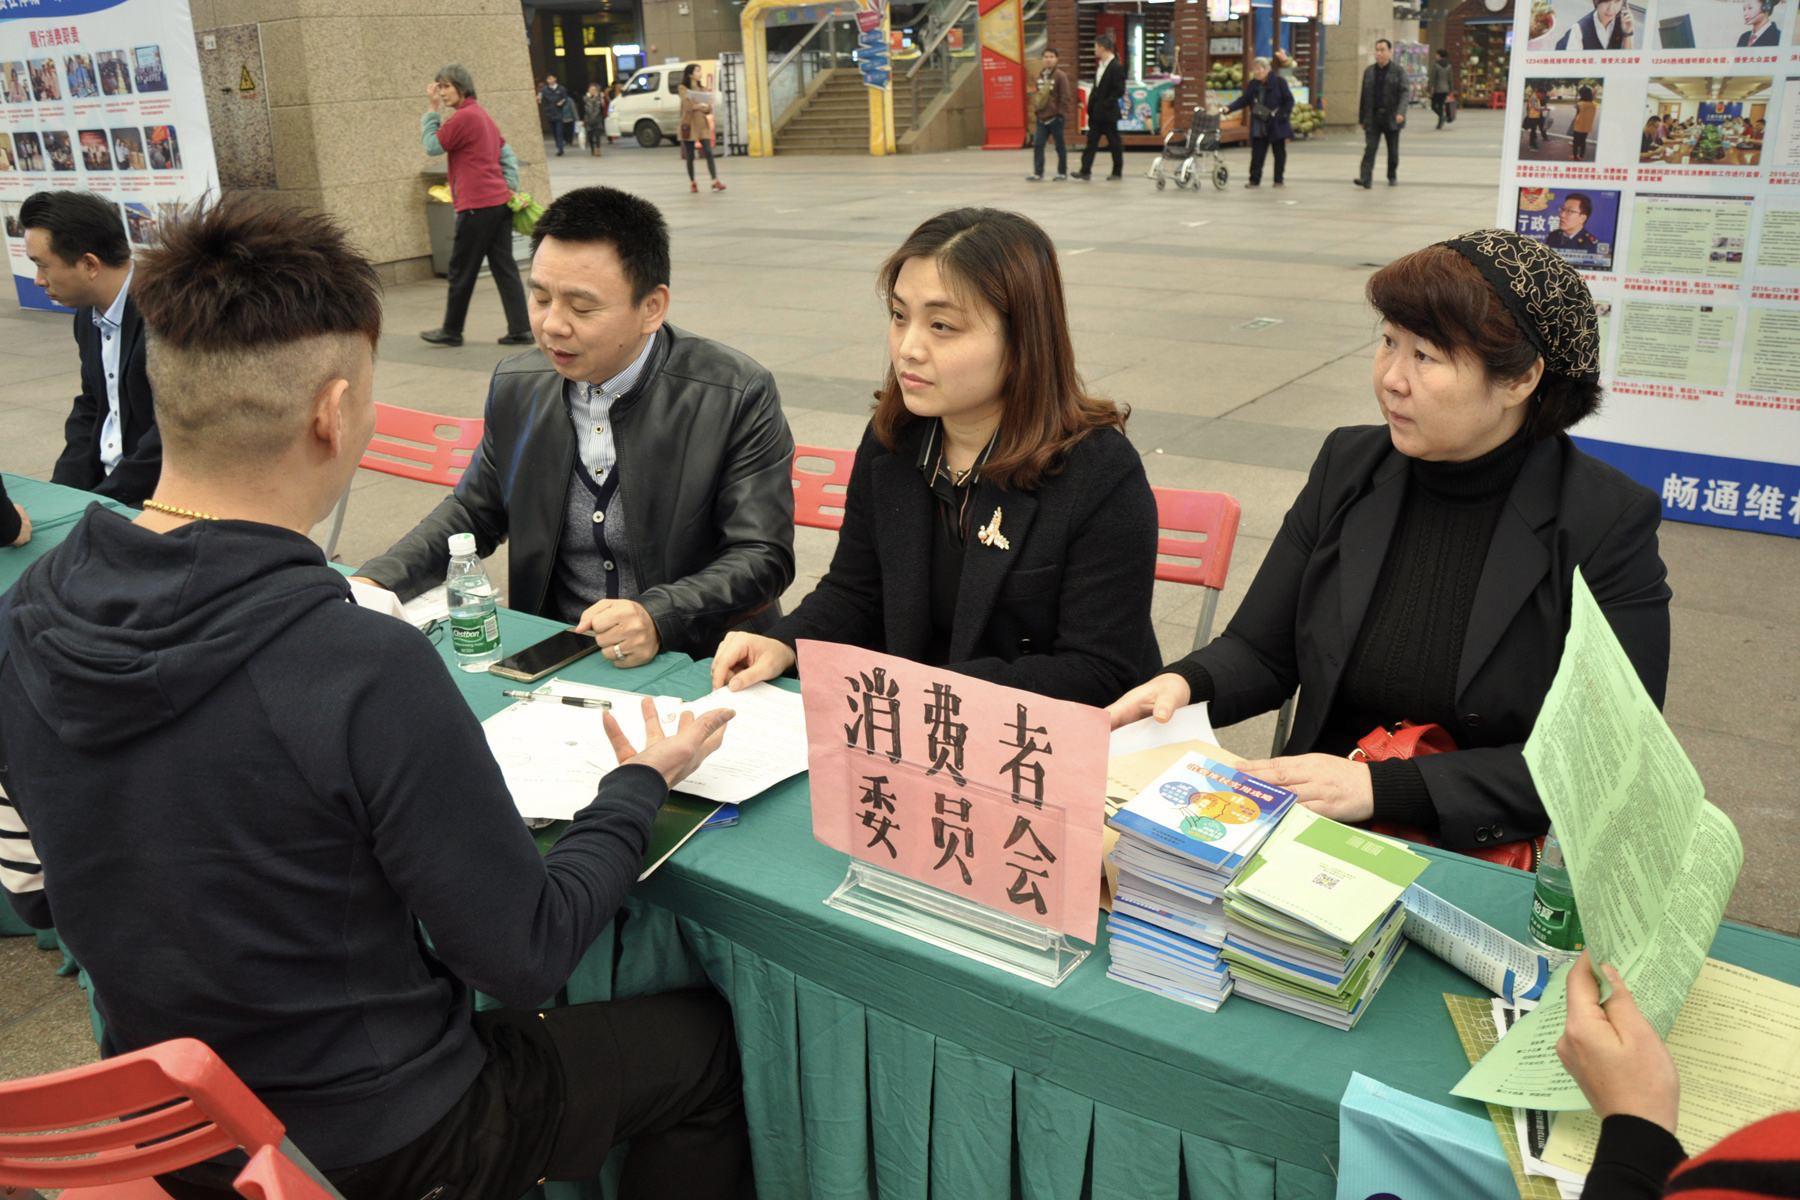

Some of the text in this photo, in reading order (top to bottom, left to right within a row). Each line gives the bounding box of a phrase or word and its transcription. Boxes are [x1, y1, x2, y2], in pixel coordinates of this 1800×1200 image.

[844, 666, 1053, 812] 消费者
[855, 774, 1058, 916] 委员会
